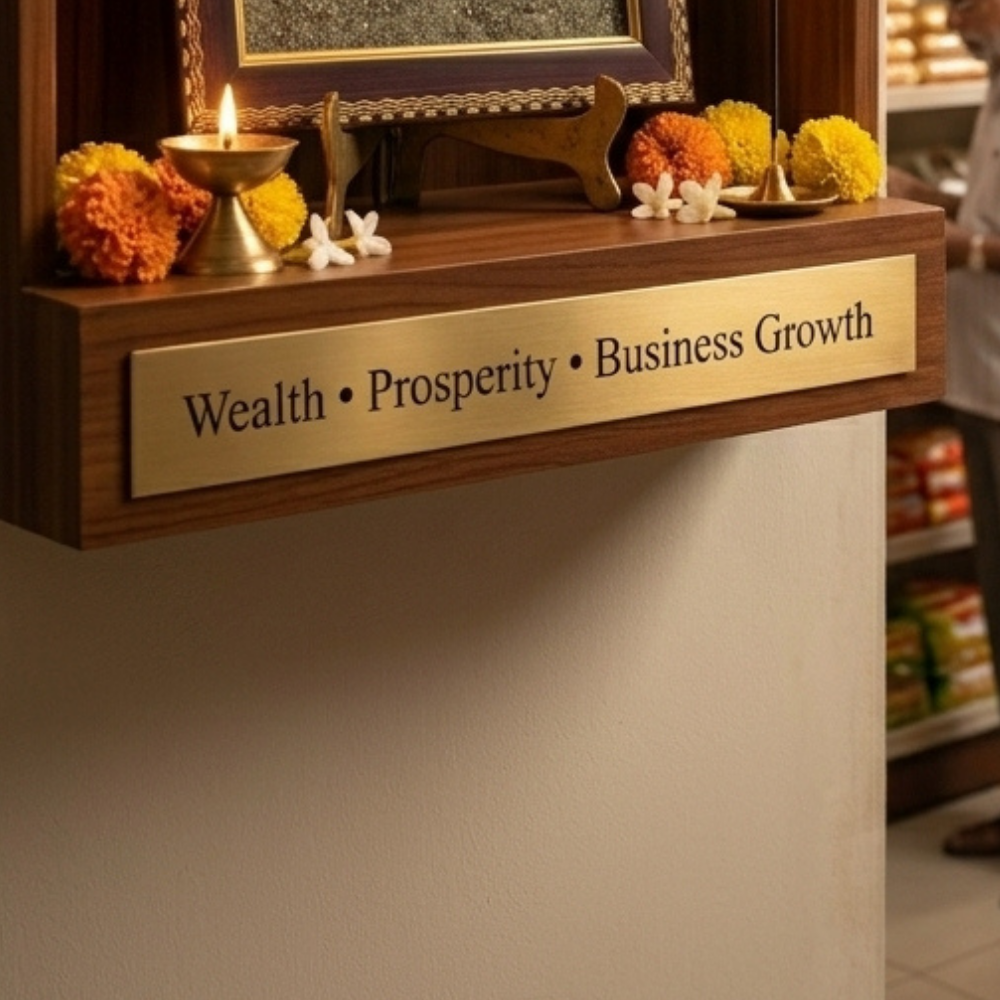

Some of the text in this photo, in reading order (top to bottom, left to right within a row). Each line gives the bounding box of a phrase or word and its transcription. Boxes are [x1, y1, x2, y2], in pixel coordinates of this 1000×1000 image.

[184, 301, 875, 440] Wealth Prosperity Business Growth
